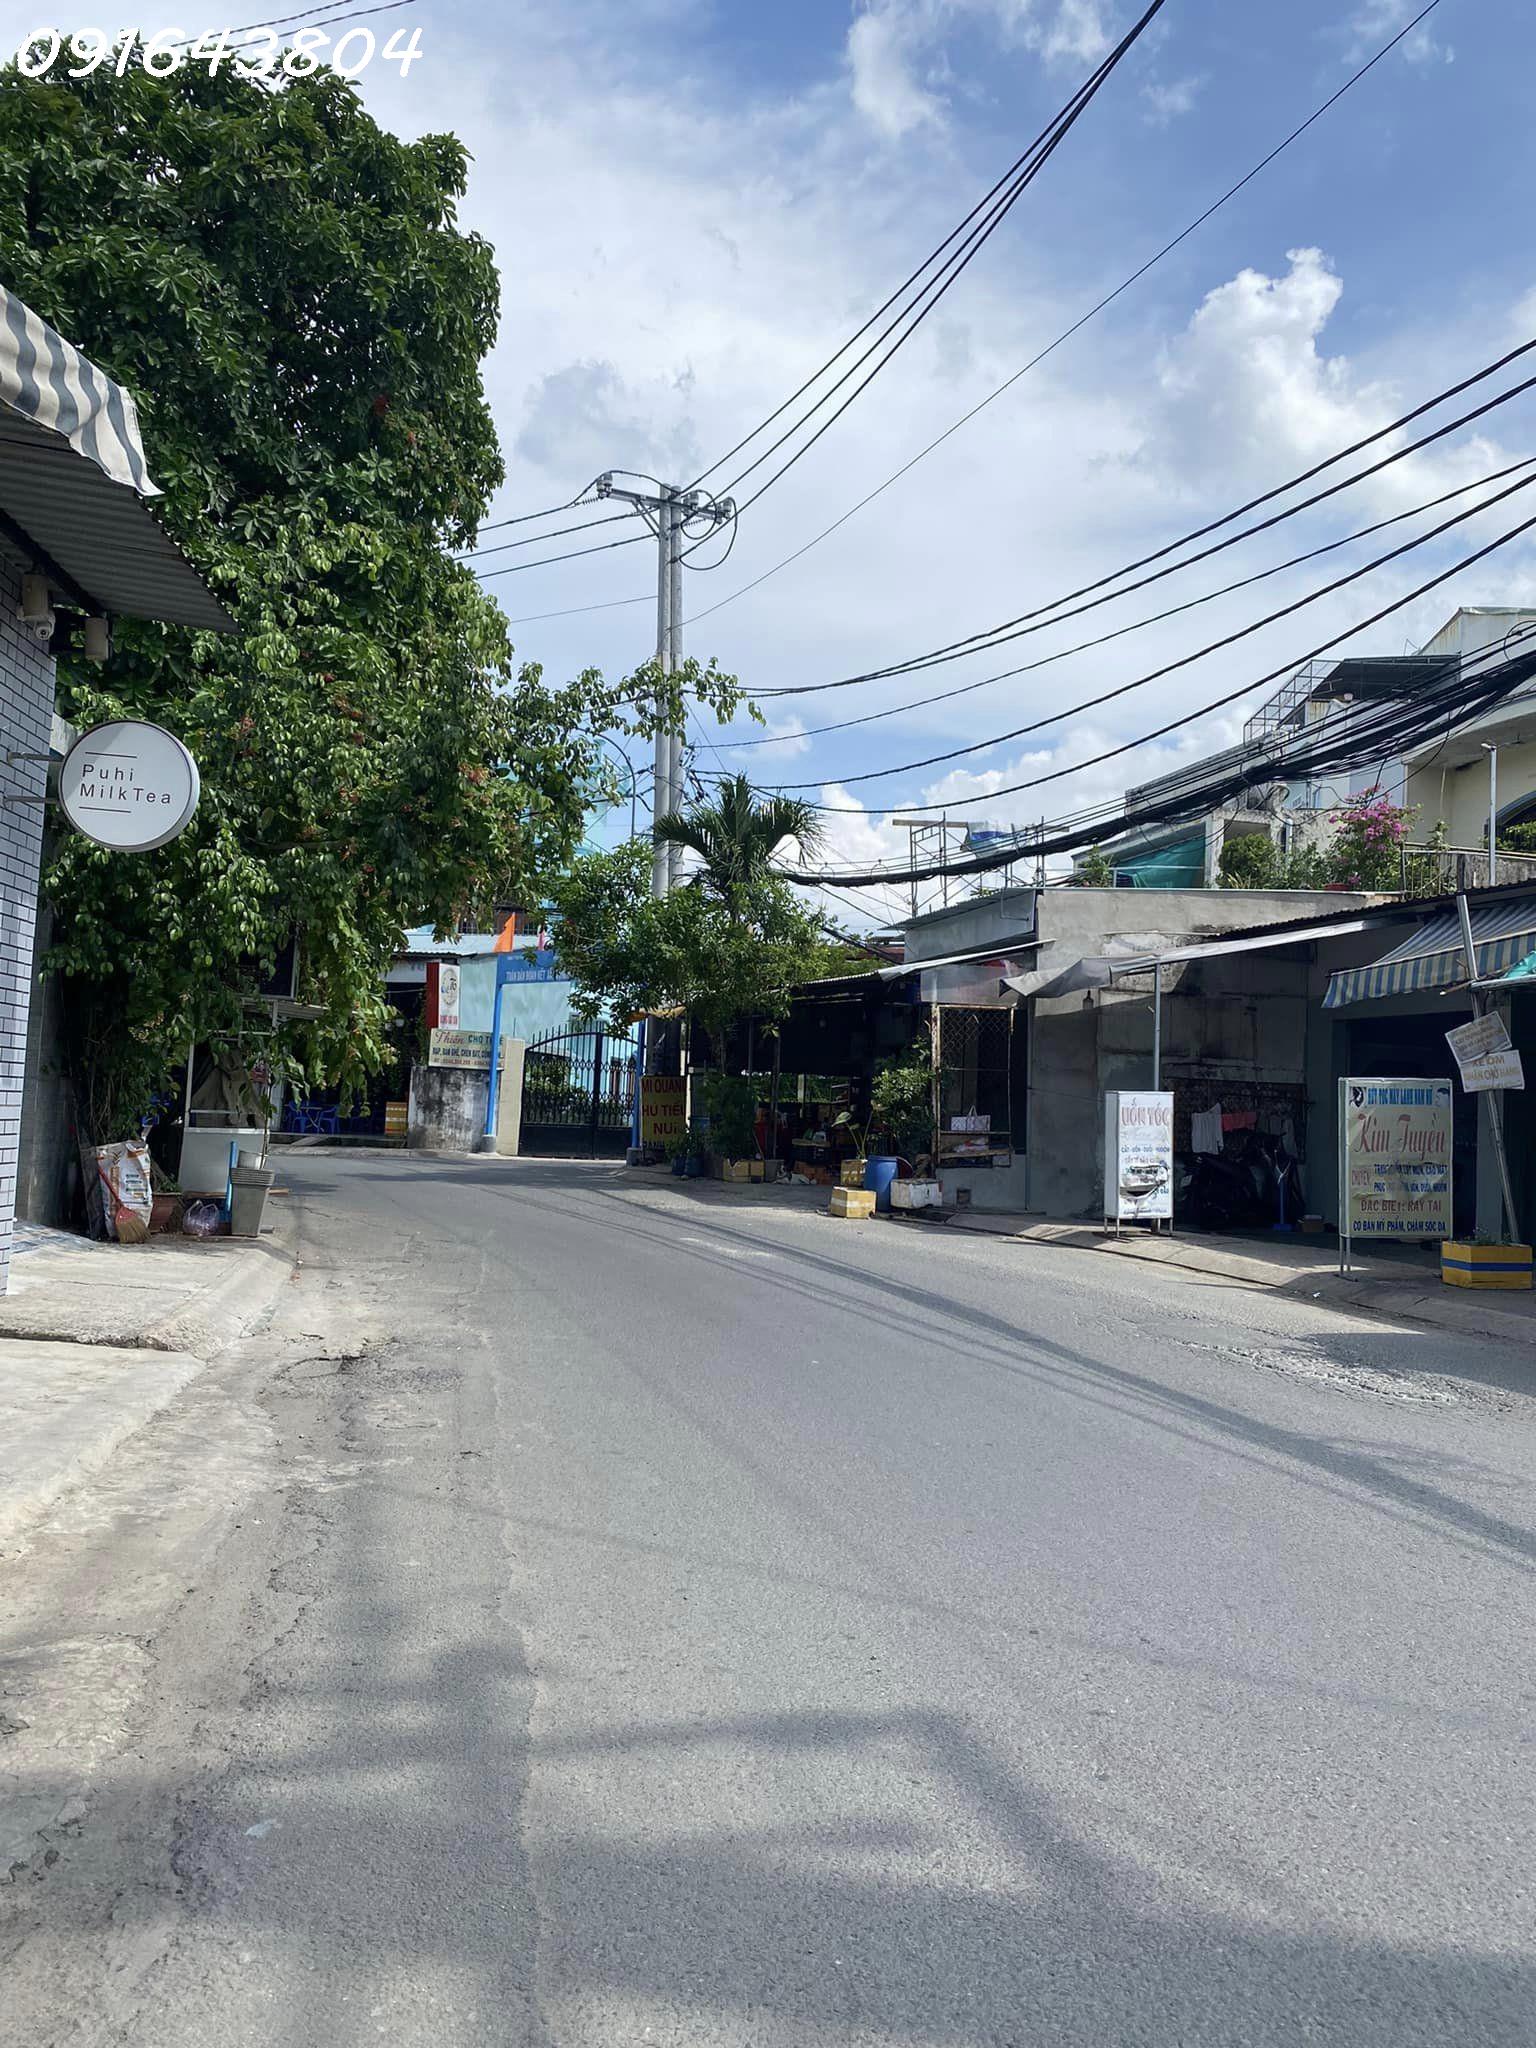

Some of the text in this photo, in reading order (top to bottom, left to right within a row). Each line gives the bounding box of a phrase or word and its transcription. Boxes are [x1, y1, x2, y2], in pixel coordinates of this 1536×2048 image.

[82, 763, 134, 782] Puhi
[80, 783, 171, 805] MilkTea
[1354, 1114, 1390, 1152] Kim
